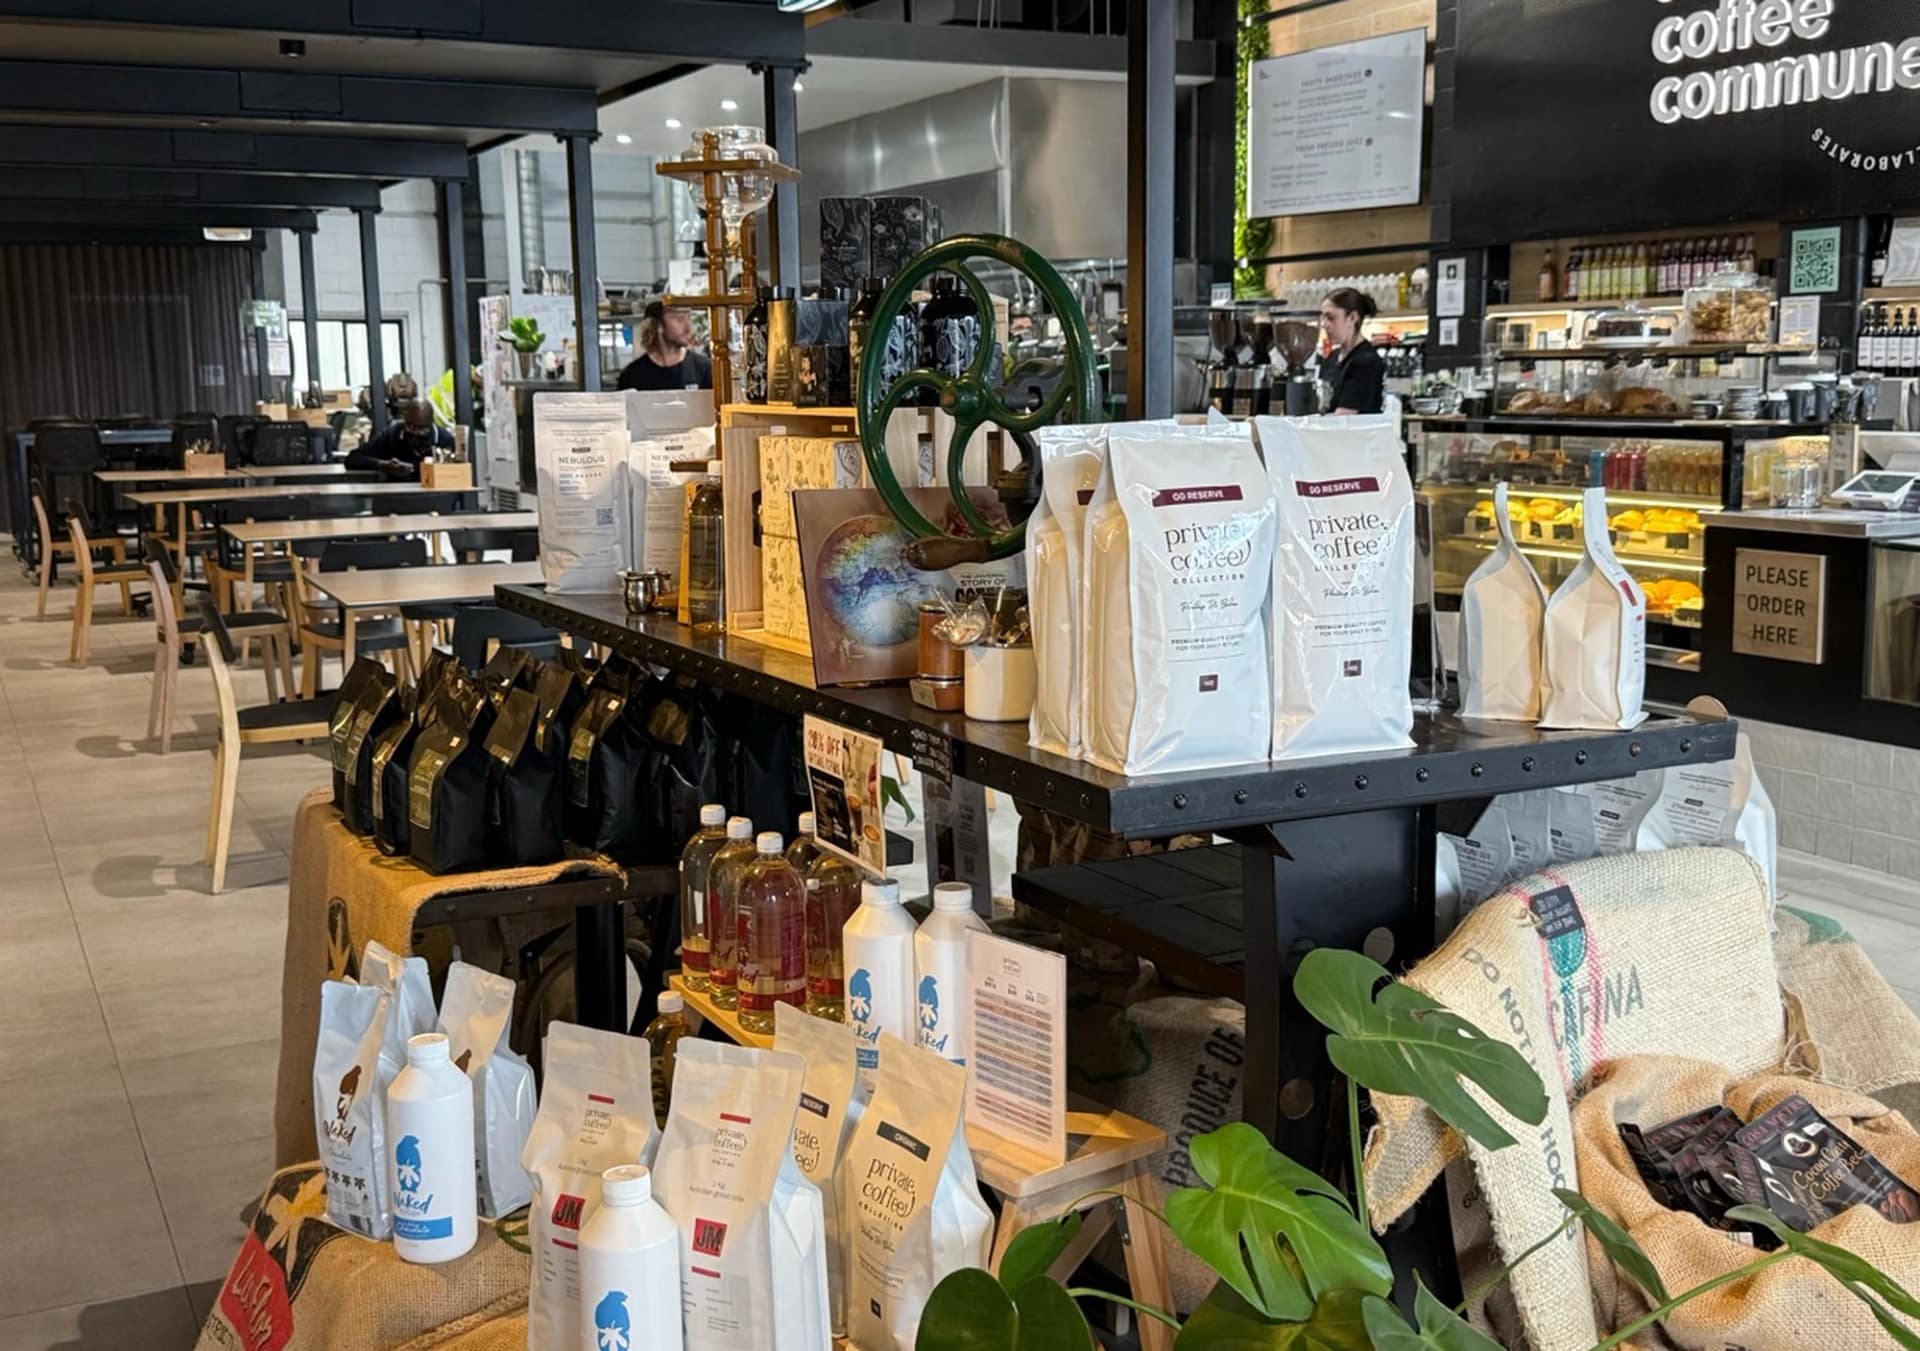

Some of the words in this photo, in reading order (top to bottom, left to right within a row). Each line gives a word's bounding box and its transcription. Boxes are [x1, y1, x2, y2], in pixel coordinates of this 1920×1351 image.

[1651, 0, 1834, 63] coffee
[558, 456, 605, 465] NEBULOUS
[1187, 489, 1224, 499] RESERVE
[1322, 482, 1361, 493] RESERVE
[960, 579, 992, 587] STORY
[1173, 573, 1245, 585] COLLECTION
[1746, 565, 1809, 588] PLEASE
[1747, 594, 1805, 617] ORDER
[1752, 624, 1799, 646] HERE
[1460, 948, 1500, 983] DO
[1204, 1026, 1244, 1066] OF
[1792, 1160, 1829, 1190] Cocoa
[1809, 1168, 1843, 1200] Coffee
[556, 1201, 579, 1225] JM
[696, 1223, 724, 1252] JM
